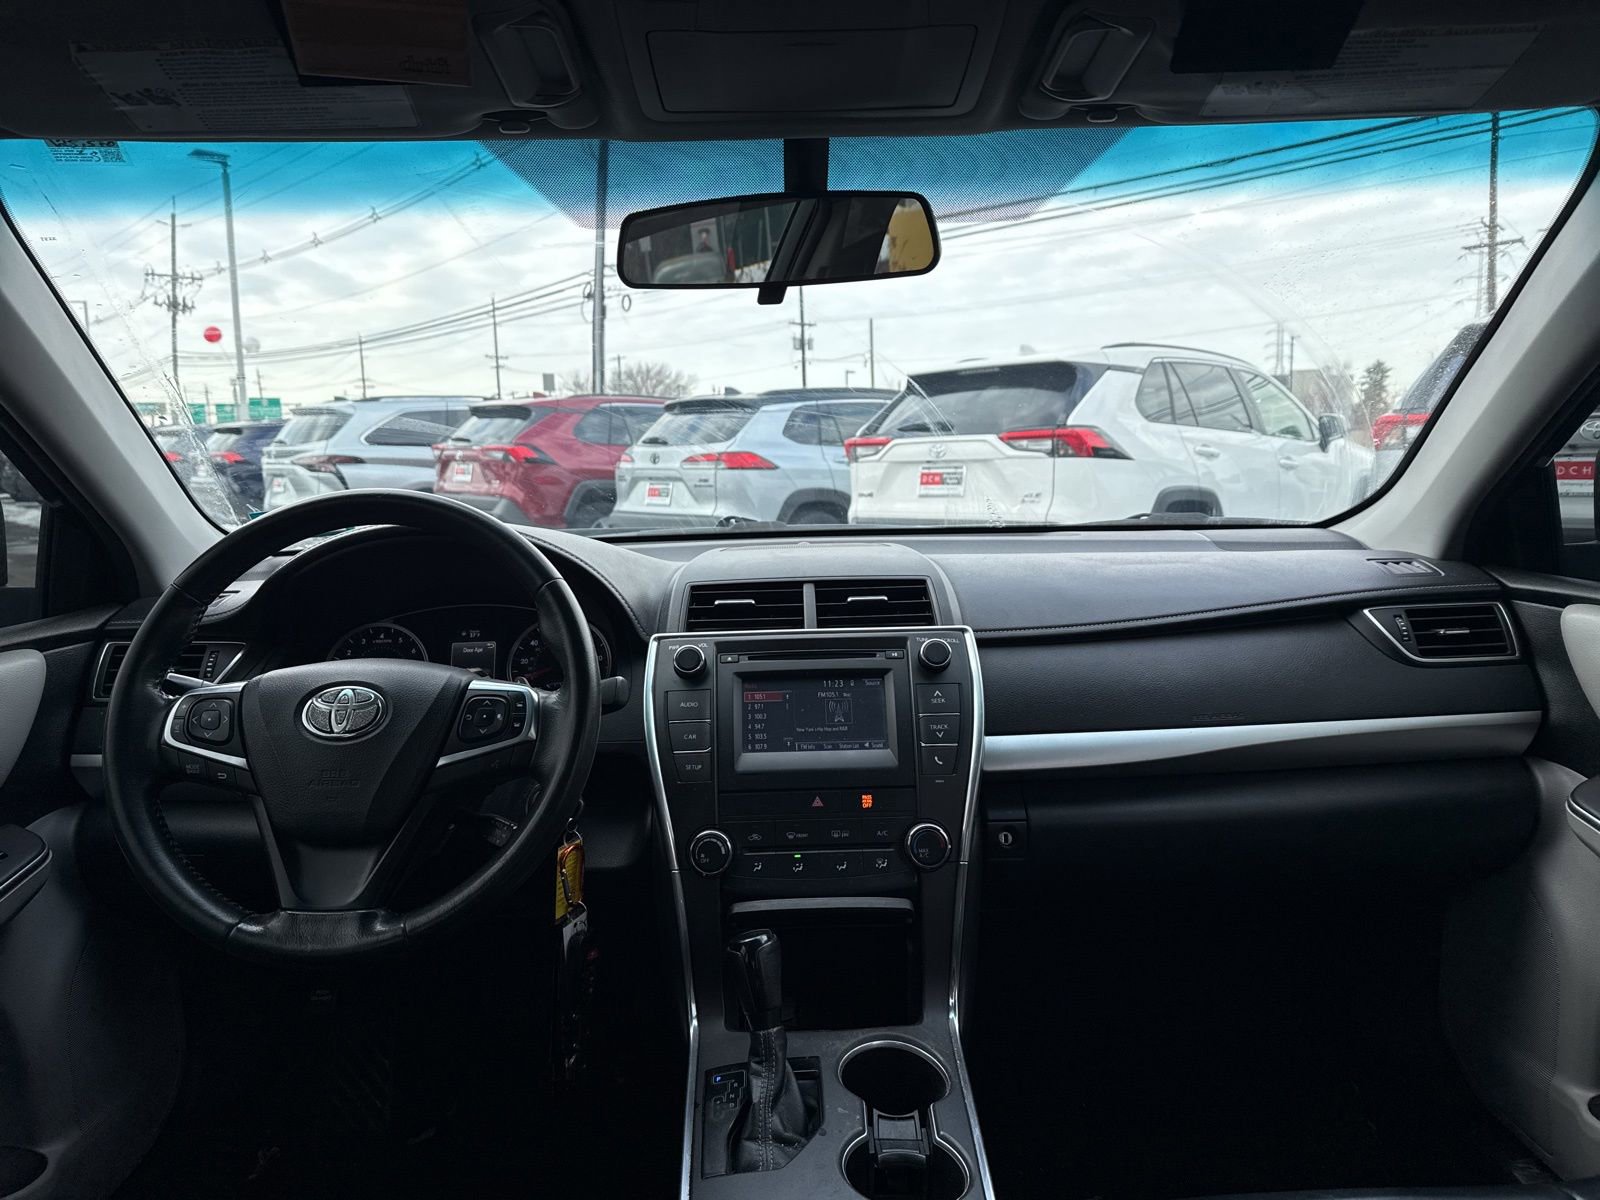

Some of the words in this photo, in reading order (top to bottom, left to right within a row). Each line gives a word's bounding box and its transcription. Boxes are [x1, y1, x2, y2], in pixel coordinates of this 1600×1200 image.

[1556, 465, 1592, 475] DCH
[529, 639, 539, 647] 40
[823, 680, 844, 688] 11:23
